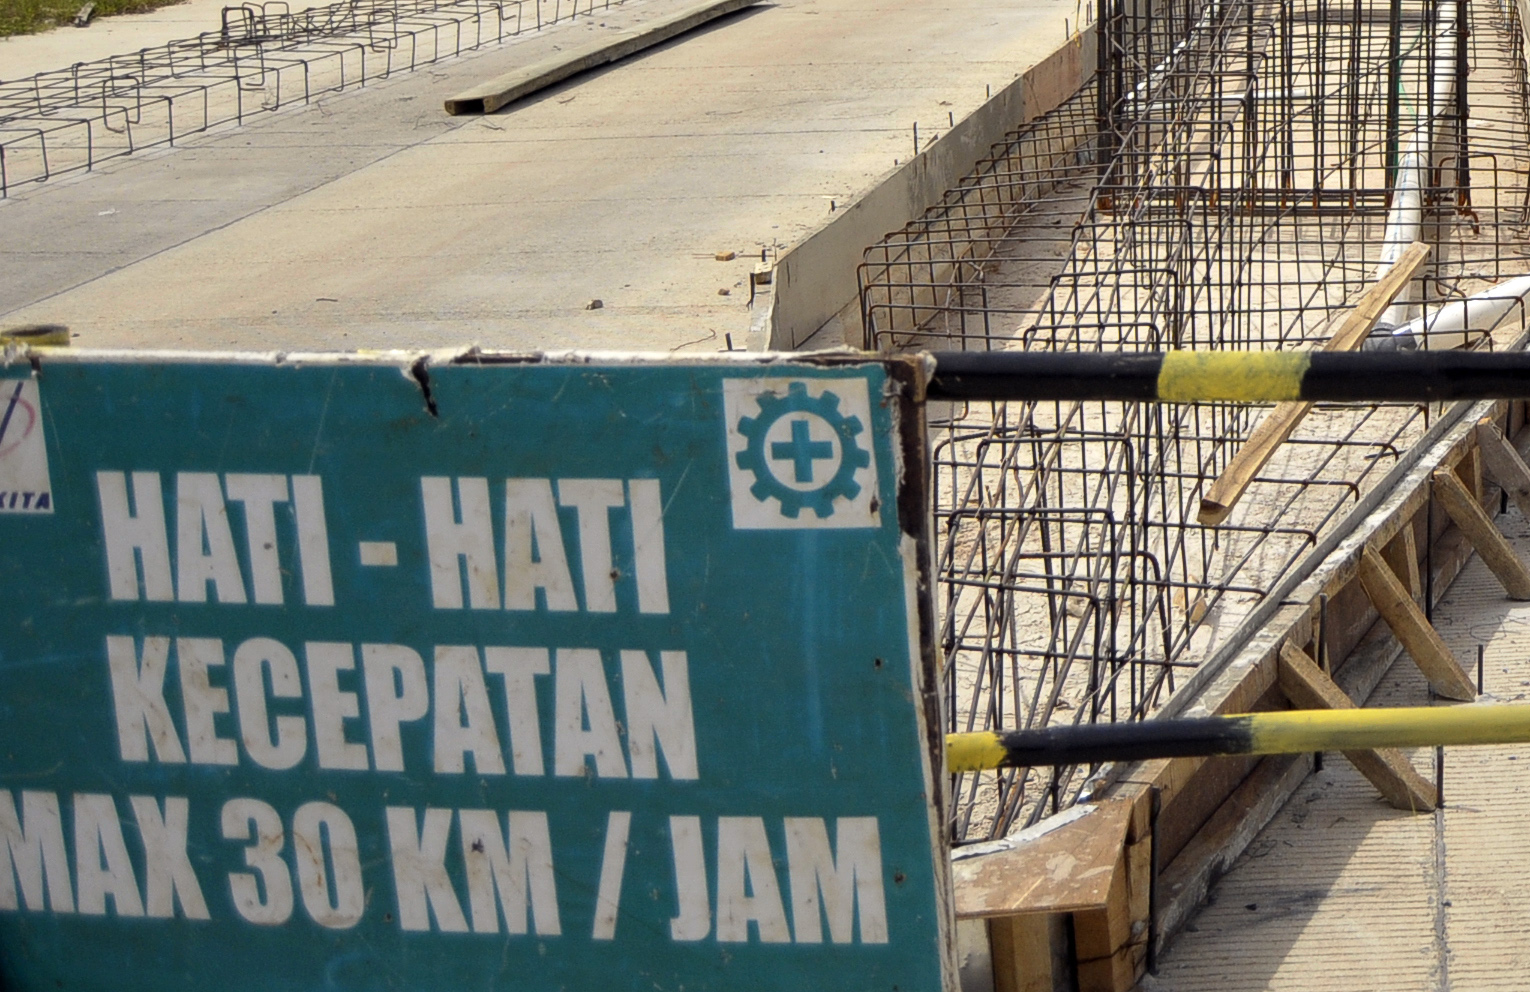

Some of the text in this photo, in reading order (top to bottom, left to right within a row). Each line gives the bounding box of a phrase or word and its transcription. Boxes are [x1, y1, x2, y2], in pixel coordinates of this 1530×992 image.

[97, 471, 671, 614] HATI - HATI
[106, 635, 699, 780] KECEPATAN
[0, 790, 889, 945] MAX 30 KM / JAM
